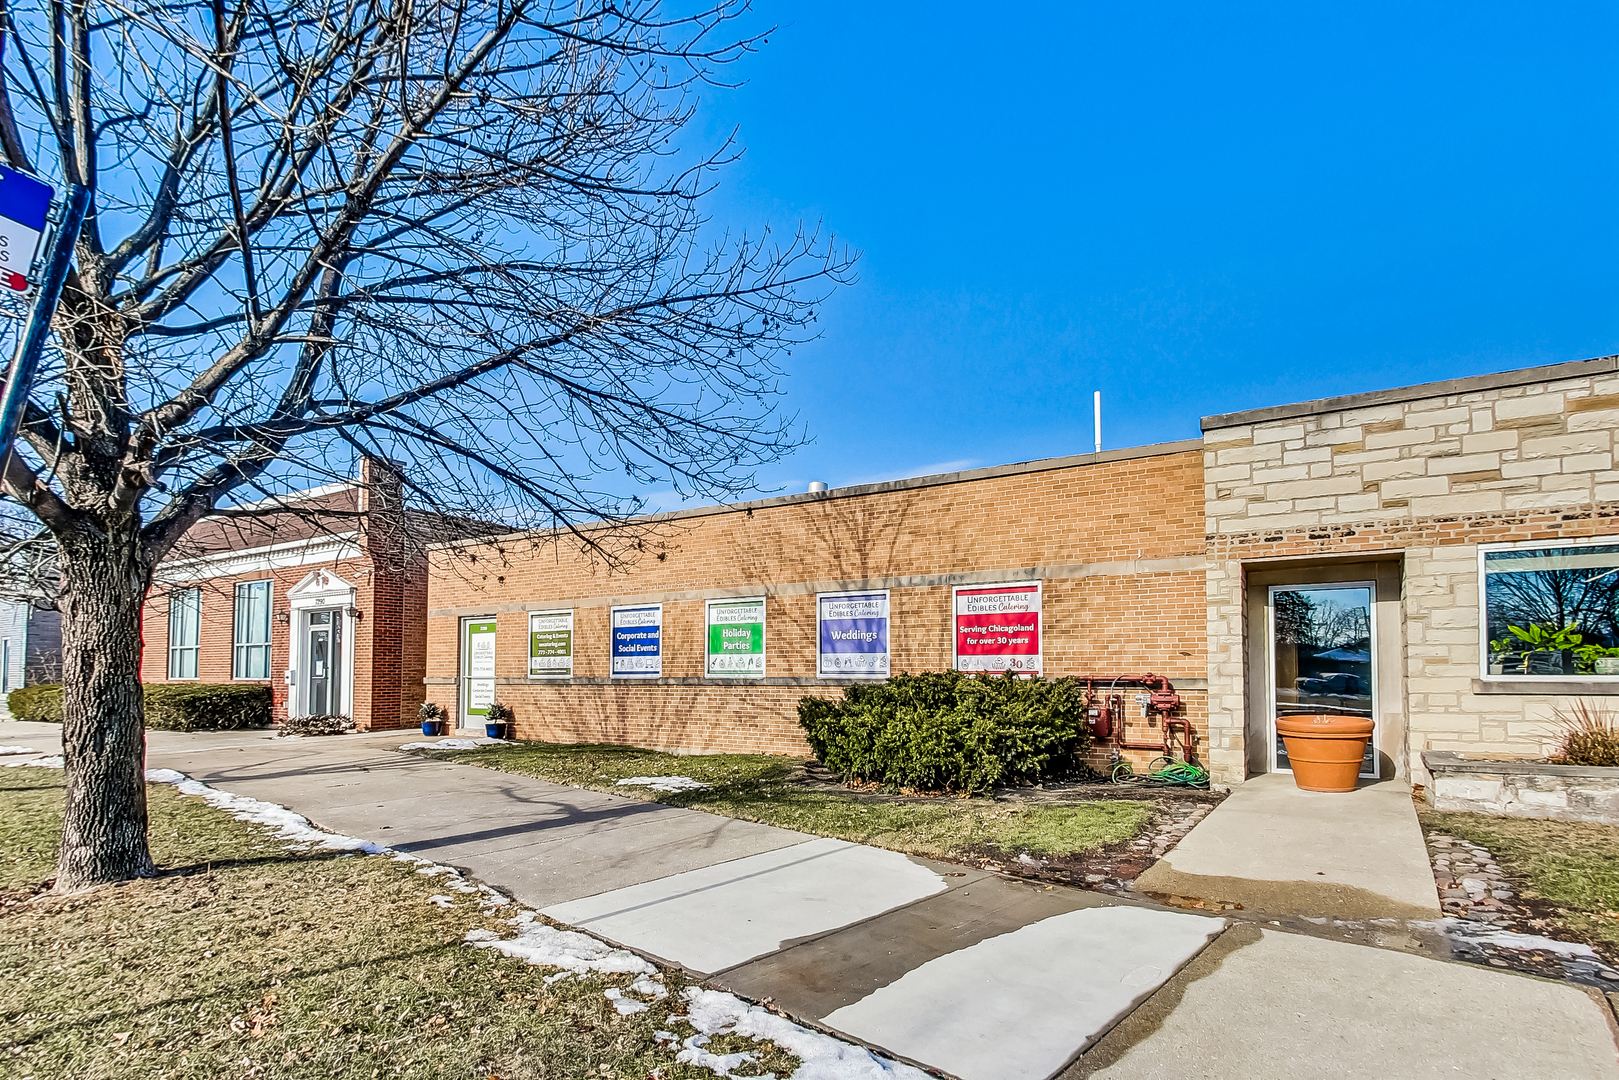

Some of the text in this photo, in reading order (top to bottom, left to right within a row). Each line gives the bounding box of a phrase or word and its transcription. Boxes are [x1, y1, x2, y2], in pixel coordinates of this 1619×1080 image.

[967, 594, 1029, 603] UNFORGETTABLE
[967, 602, 1030, 612] EDIBLES Catering
[854, 609, 879, 617] Catering
[737, 614, 758, 622] Catering
[959, 623, 1034, 634] Serving Chicagoland
[616, 630, 659, 642] Corporate and
[722, 628, 751, 639] Holiday
[831, 630, 878, 642] Weddings
[723, 641, 750, 650] Parties
[966, 637, 978, 645] for
[1008, 637, 1029, 646] years
[618, 644, 657, 652] Social Events
[1010, 658, 1023, 669] 30
